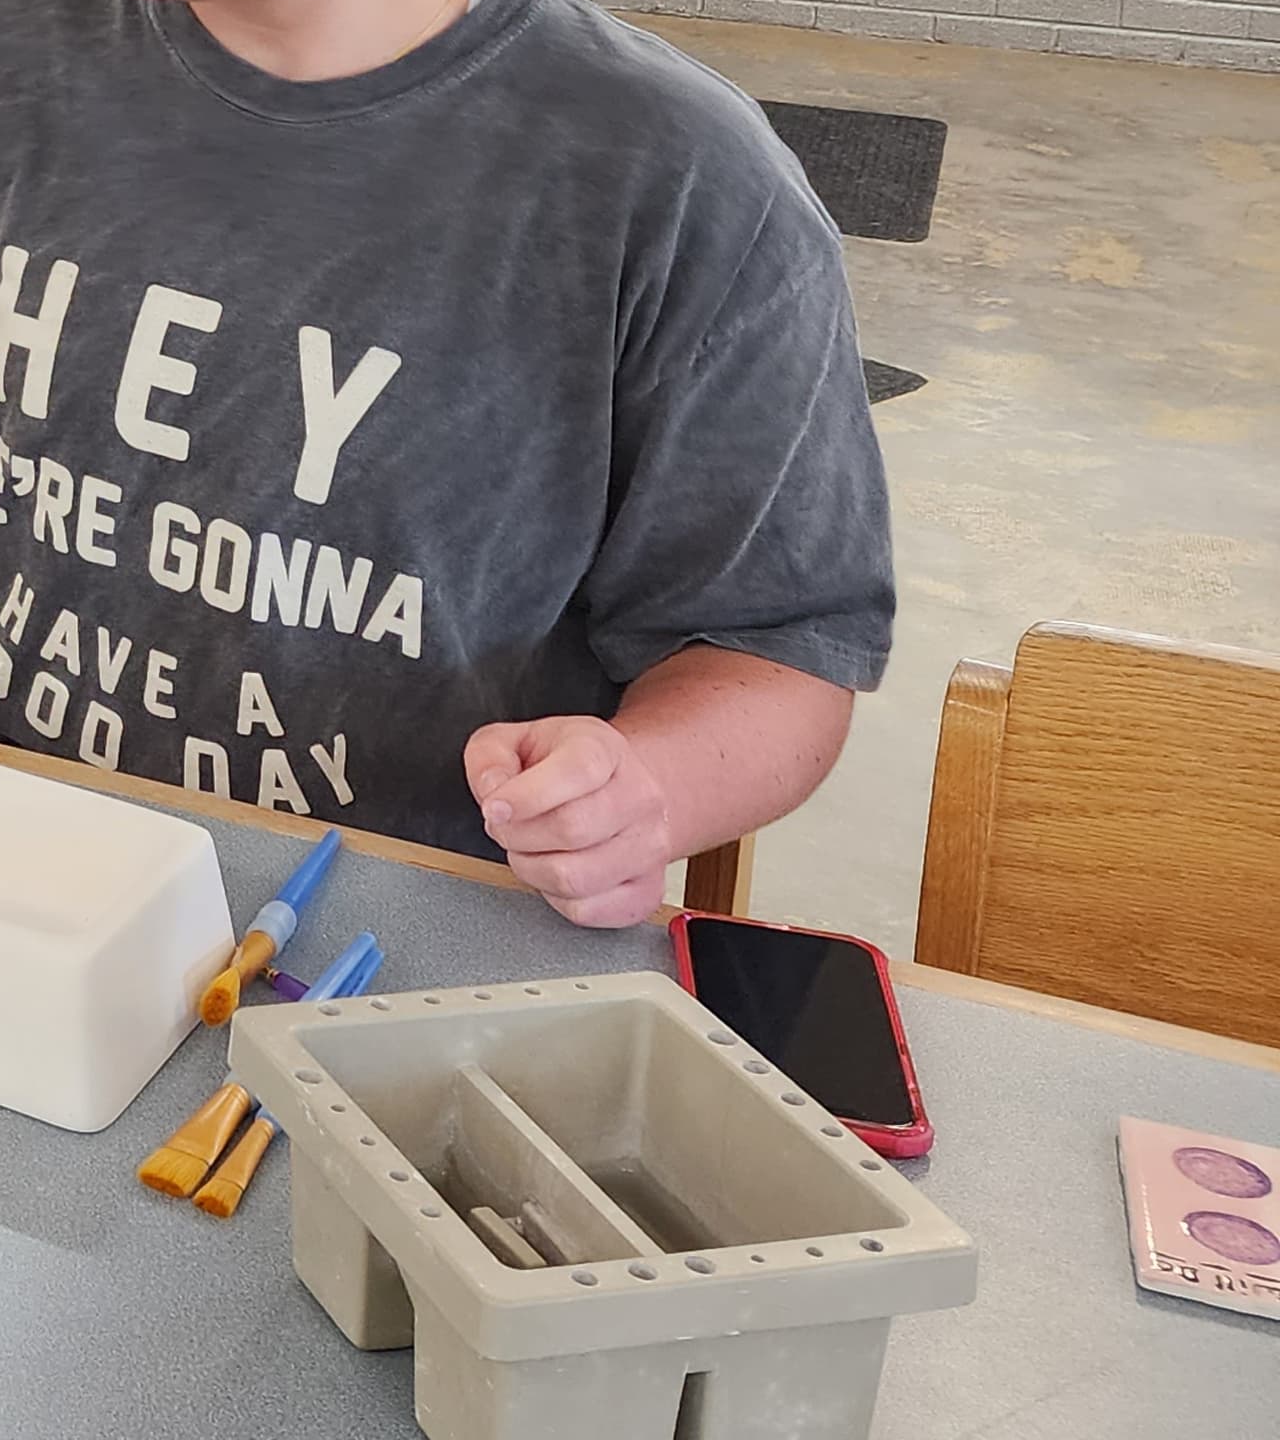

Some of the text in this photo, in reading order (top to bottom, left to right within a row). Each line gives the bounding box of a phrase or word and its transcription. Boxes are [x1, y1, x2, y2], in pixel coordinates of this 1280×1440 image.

[148, 500, 424, 660] GONNA
[236, 671, 285, 737] A
[183, 734, 355, 815] DAY
